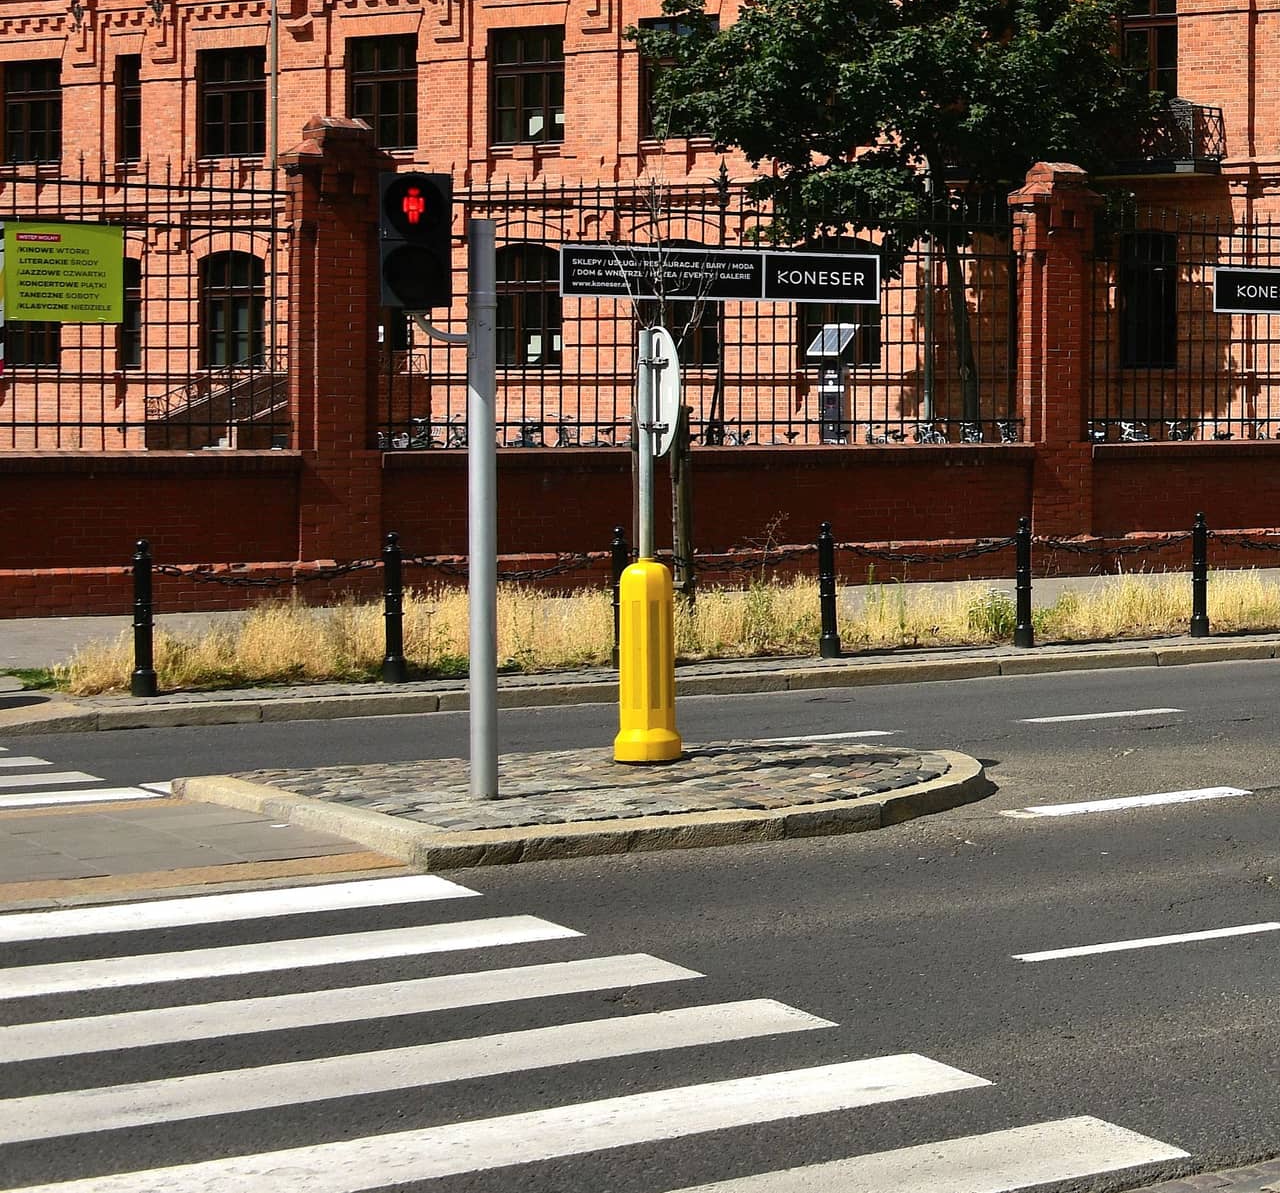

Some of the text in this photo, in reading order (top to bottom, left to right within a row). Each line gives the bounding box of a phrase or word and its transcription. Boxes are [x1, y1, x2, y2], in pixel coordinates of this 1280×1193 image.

[56, 247, 90, 255] WTORKI
[643, 260, 700, 268] RESAURACJE
[63, 270, 106, 278] CZWARTKI
[719, 272, 751, 280] GALERIE
[777, 269, 865, 286] KONESER
[65, 292, 100, 300] SOBOTY
[71, 304, 112, 312] NIEDZIELE
